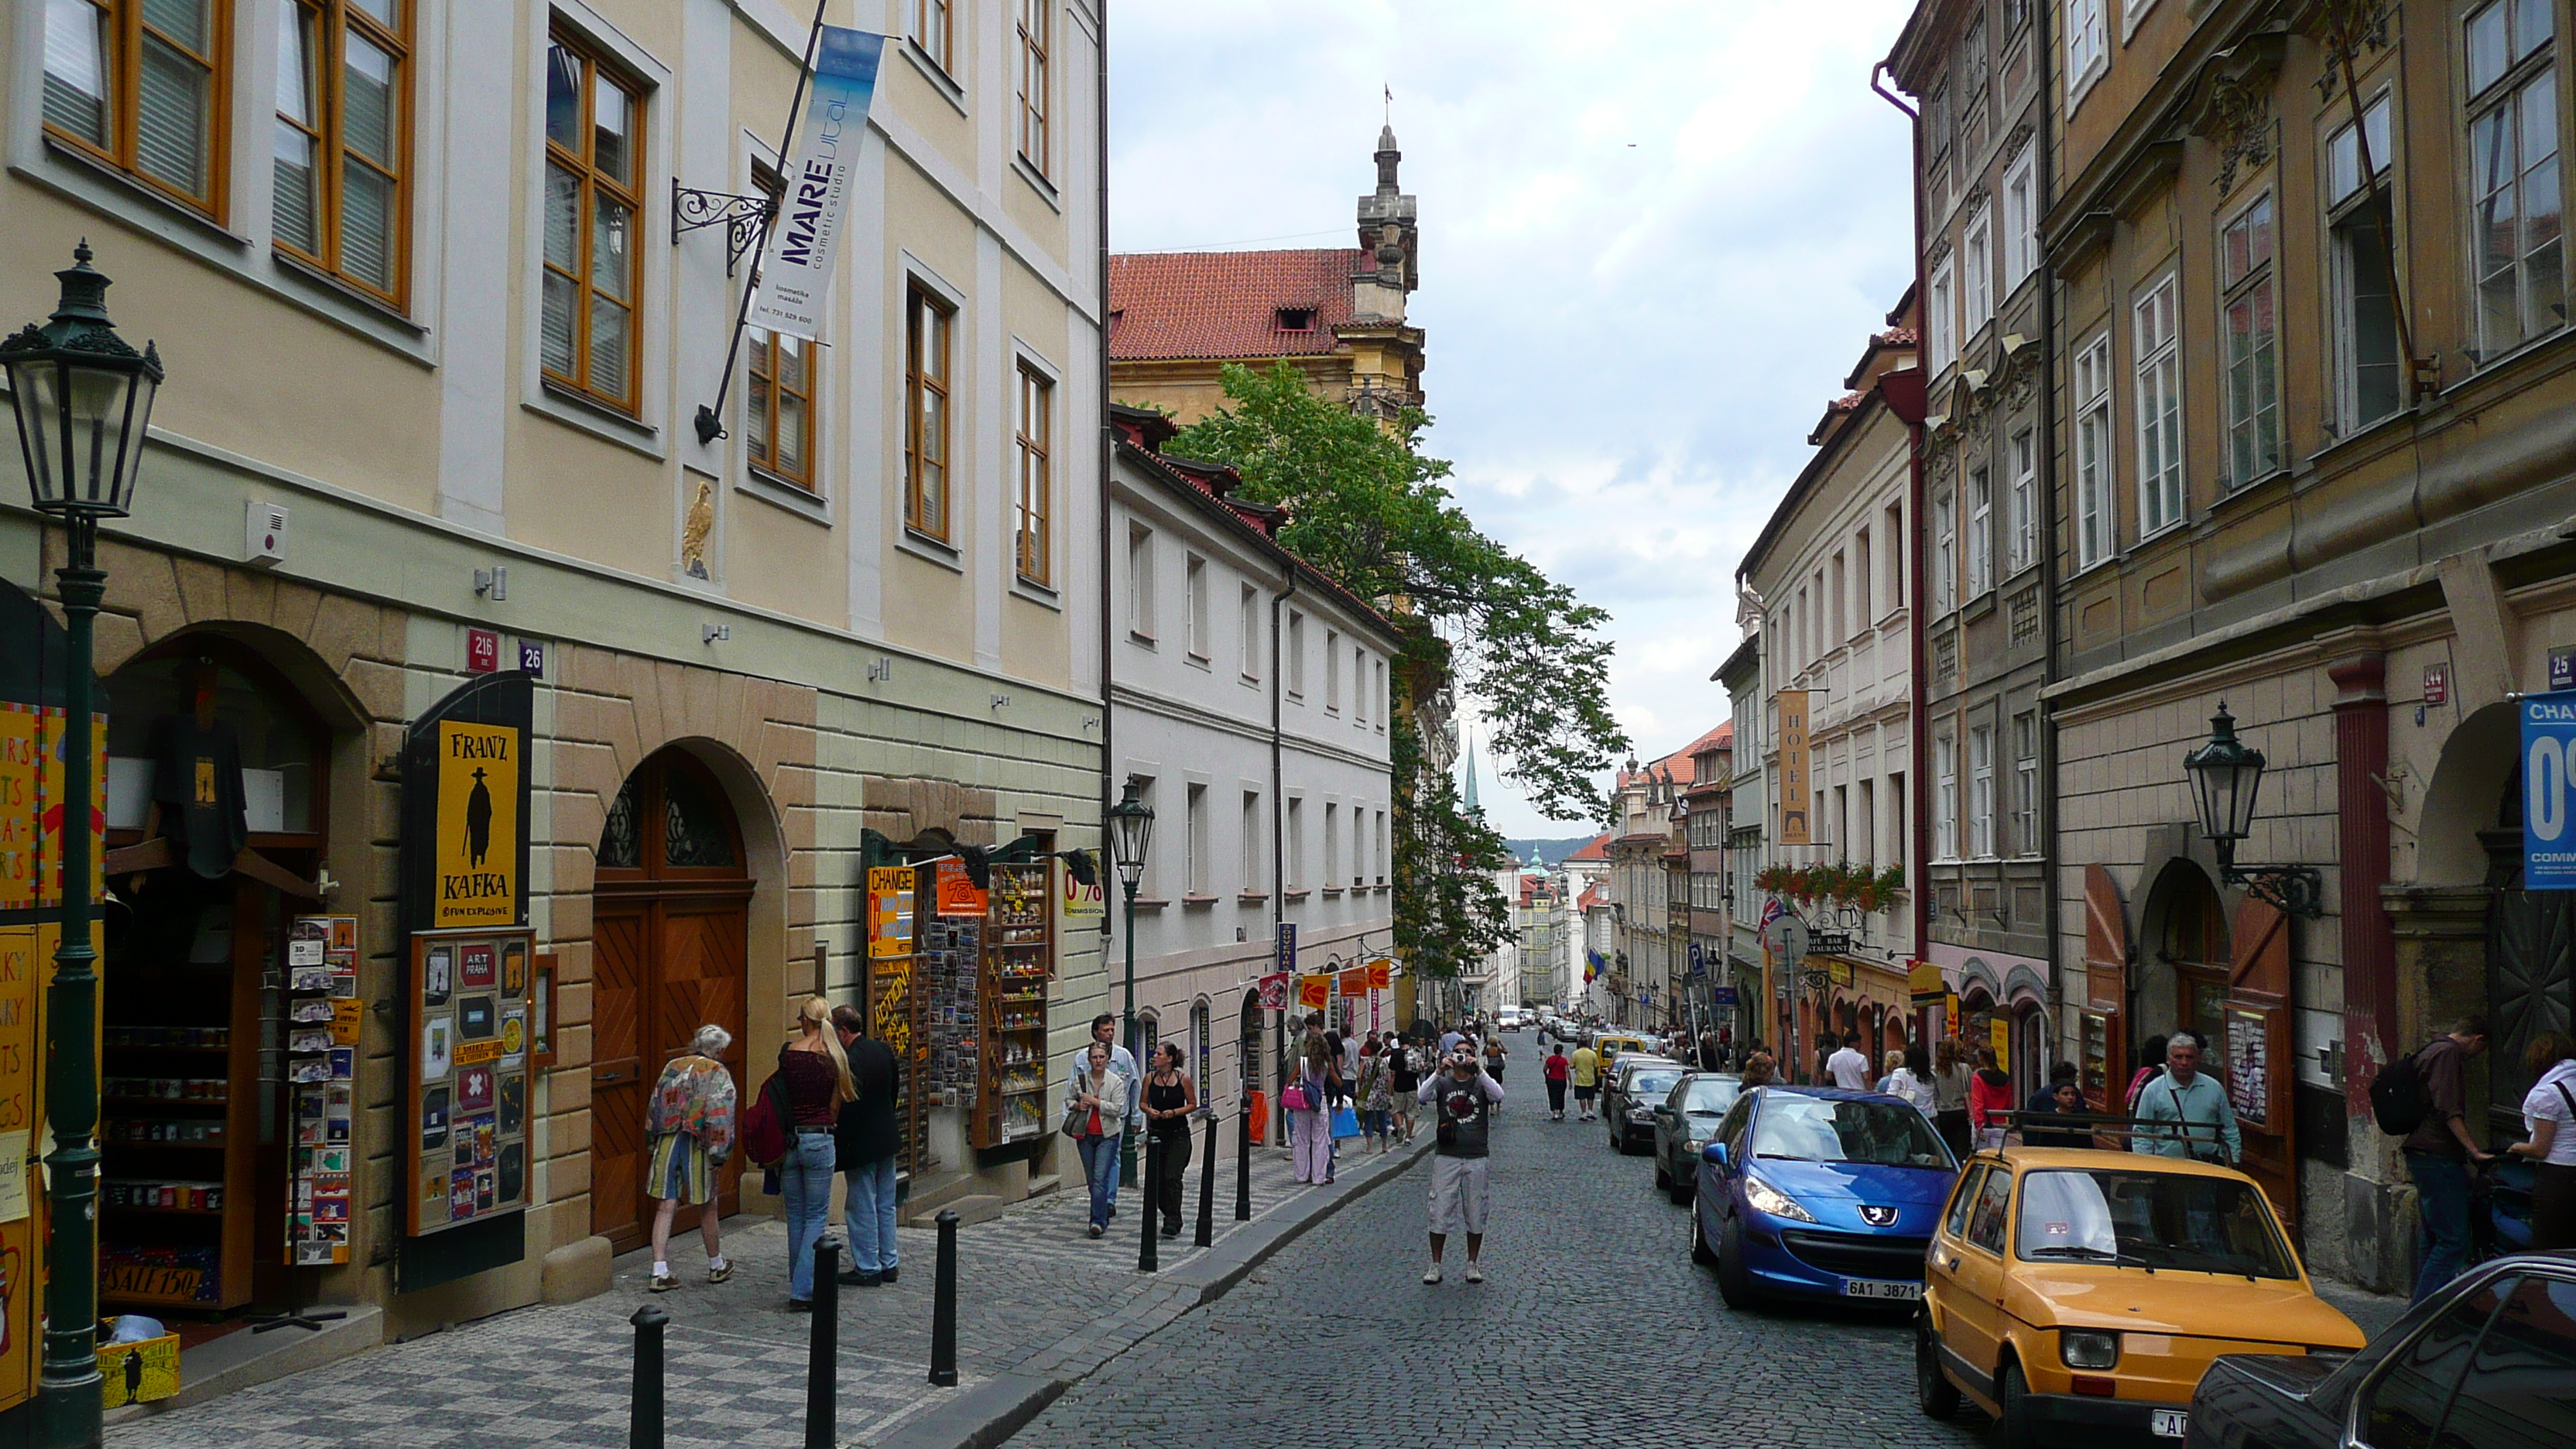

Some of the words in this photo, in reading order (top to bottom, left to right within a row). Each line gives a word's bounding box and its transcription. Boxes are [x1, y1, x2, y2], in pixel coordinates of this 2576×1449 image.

[780, 159, 833, 266] MARE
[814, 211, 835, 270] cosmetic
[829, 165, 846, 207] studio
[776, 284, 809, 298] kosmetika
[475, 636, 492, 656] 216
[526, 649, 541, 668] 26
[2554, 656, 2567, 674] 25
[2530, 704, 2576, 719] CHA
[0, 738, 29, 765] IRTS
[451, 732, 508, 762] FRANZ
[1786, 715, 1801, 801] HOTEL
[0, 776, 22, 806] TS
[2528, 735, 2576, 841] 0
[444, 873, 509, 899] KAFKA
[872, 869, 913, 890] CHANGE
[467, 906, 508, 916] EXPLOSIVE
[881, 896, 896, 911] EUR
[899, 894, 913, 913] 27
[882, 923, 896, 937] USD
[0, 951, 26, 981] KY
[467, 954, 488, 964] ART
[1690, 947, 1700, 968] P
[466, 964, 488, 975] PRAHA
[1201, 1053, 1209, 1105] CERAMIC
[110, 1266, 156, 1293] SALE
[1849, 1282, 1873, 1296] 6A1
[1883, 1284, 1915, 1298] 3871
